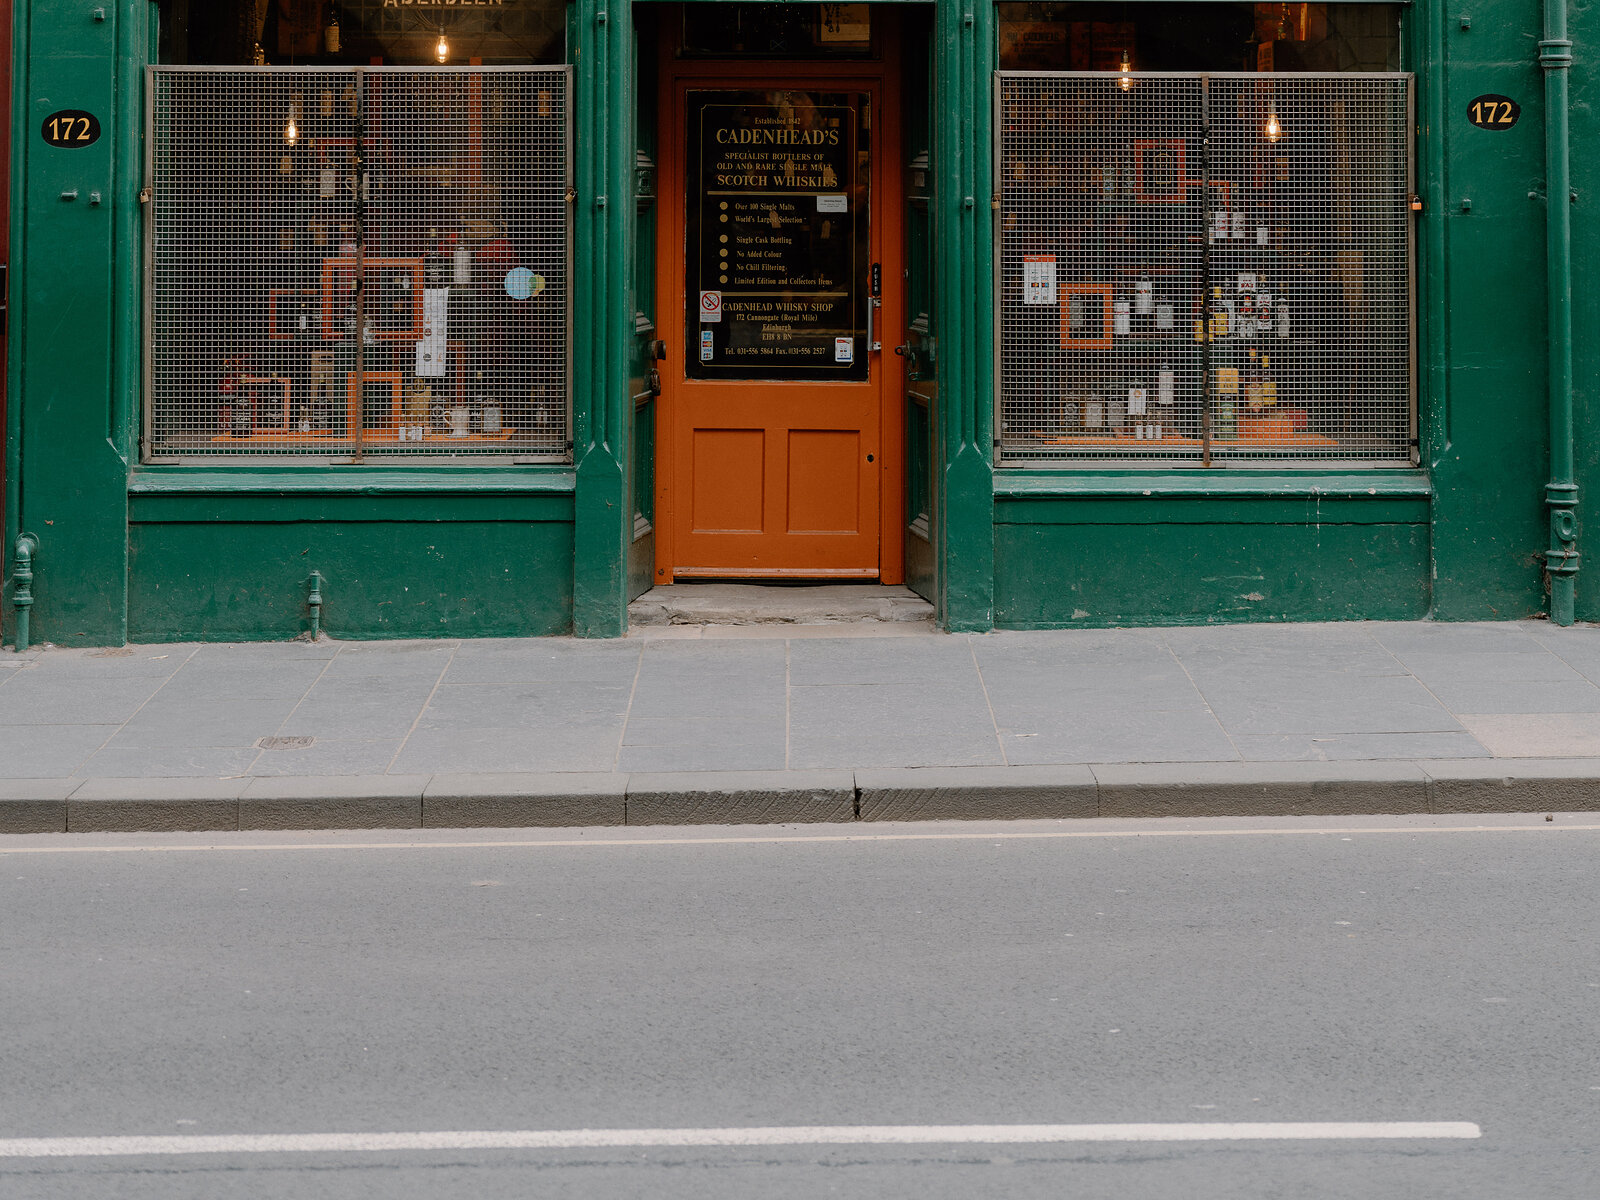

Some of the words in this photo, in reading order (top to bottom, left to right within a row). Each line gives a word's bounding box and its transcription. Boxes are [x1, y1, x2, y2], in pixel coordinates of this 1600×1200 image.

[1472, 101, 1513, 123] 172
[49, 117, 91, 140] 172
[716, 128, 839, 146] CADENHEAD'S
[725, 152, 769, 161] SPECIALIST
[772, 153, 811, 161] BOTTLERS
[814, 153, 825, 161] OF
[717, 162, 733, 170] OLD
[736, 162, 752, 170] AND
[779, 163, 808, 171] SINGLE
[717, 175, 767, 186] SCOTCH
[773, 176, 838, 187] WHISKIES
[760, 203, 777, 212] Single
[778, 216, 803, 224] Selection
[736, 236, 754, 244] Single
[755, 236, 768, 244] Cask
[770, 236, 792, 245] Bottling
[736, 250, 744, 258] No
[747, 250, 762, 258] Added
[764, 250, 782, 258] Colour
[762, 264, 786, 272] Filtering
[734, 277, 755, 285] Limited
[757, 277, 776, 285] Edition
[790, 277, 816, 285] Collectors
[722, 302, 772, 311] CADENHEAD
[776, 303, 808, 311] WHISKY
[811, 303, 834, 312] SHOP
[781, 314, 800, 322] (Royal
